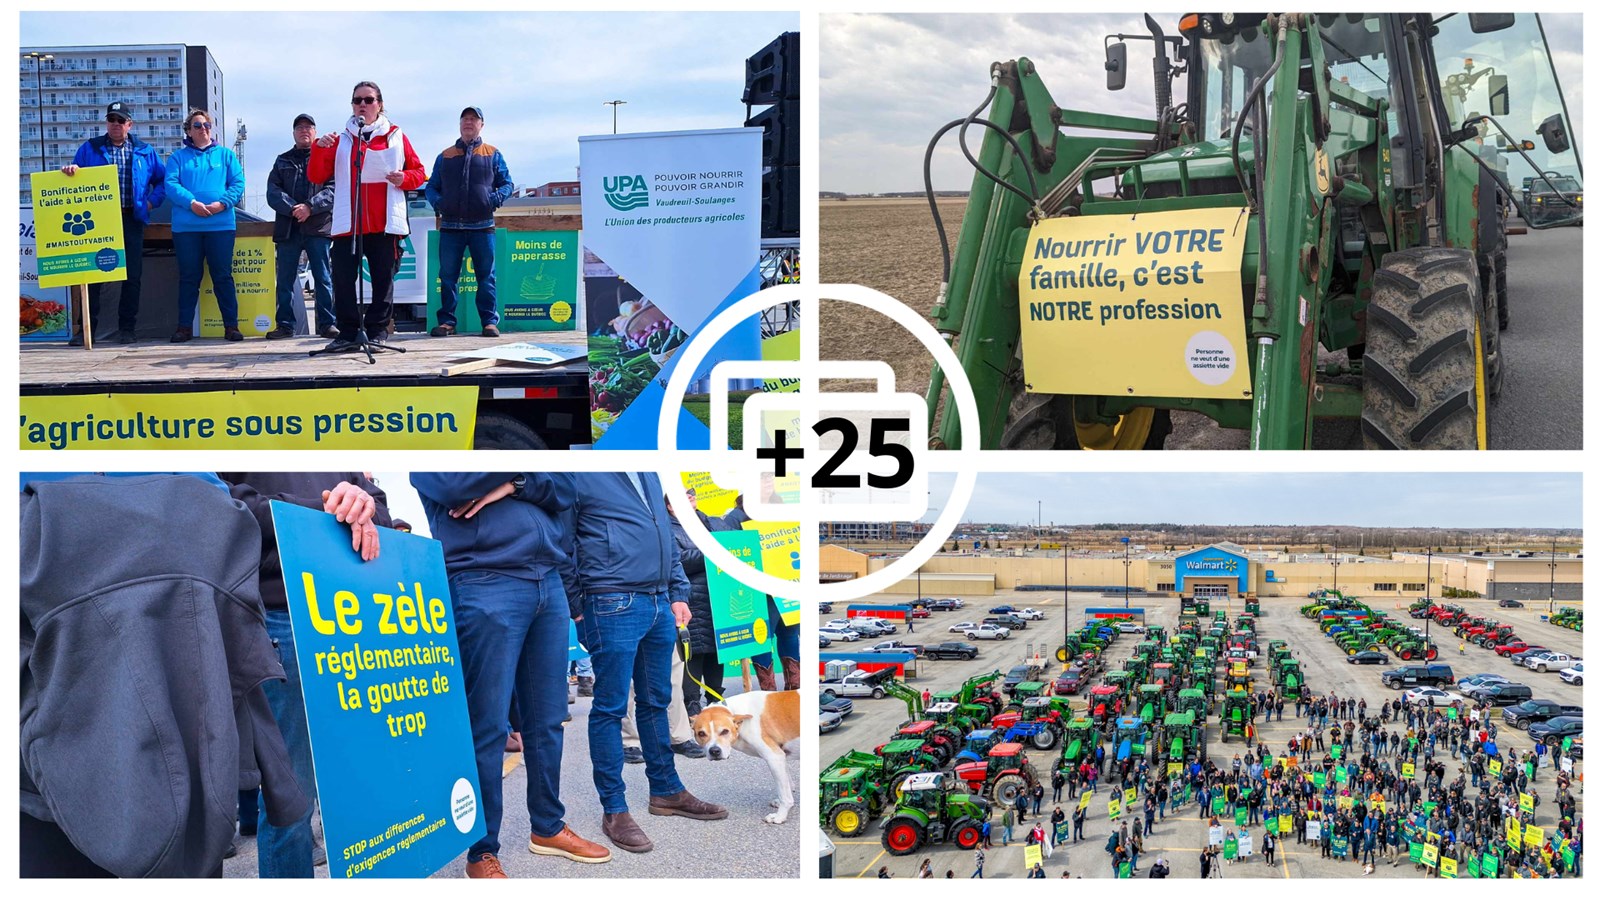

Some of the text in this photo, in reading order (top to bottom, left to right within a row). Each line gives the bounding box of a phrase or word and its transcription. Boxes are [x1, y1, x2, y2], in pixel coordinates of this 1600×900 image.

[603, 174, 648, 193] UPA
[654, 170, 743, 182] POUVOIR NOURRIR
[41, 183, 110, 197] Bonification de
[655, 180, 744, 192] POUVOIR GRANDIR
[40, 198, 64, 207] l'aide
[74, 196, 83, 204] la
[85, 194, 113, 203] relève
[656, 196, 736, 207] Vaudreuil-Soulanges
[604, 212, 746, 227] L'Union des producteurs agricoles
[45, 236, 115, 249] #MAISTOUTVABIEN
[515, 239, 562, 250] Moins de
[1033, 228, 1225, 260] Nourrir VOTRE
[236, 249, 246, 257] de
[247, 249, 252, 257] 1
[511, 252, 567, 263] paperasse
[1029, 260, 1204, 292] famille, c'est
[1030, 298, 1222, 326] NOTRE profession
[226, 411, 303, 437] sous
[313, 405, 459, 442] pression
[1186, 560, 1225, 570] Walmart
[301, 571, 449, 636] Le zèle
[314, 640, 455, 681] réglementaire,
[337, 670, 450, 714] la goutte de
[386, 710, 428, 738] trop
[343, 812, 426, 861] STOP aux différences
[346, 817, 447, 878] d'exigences réglementaires
